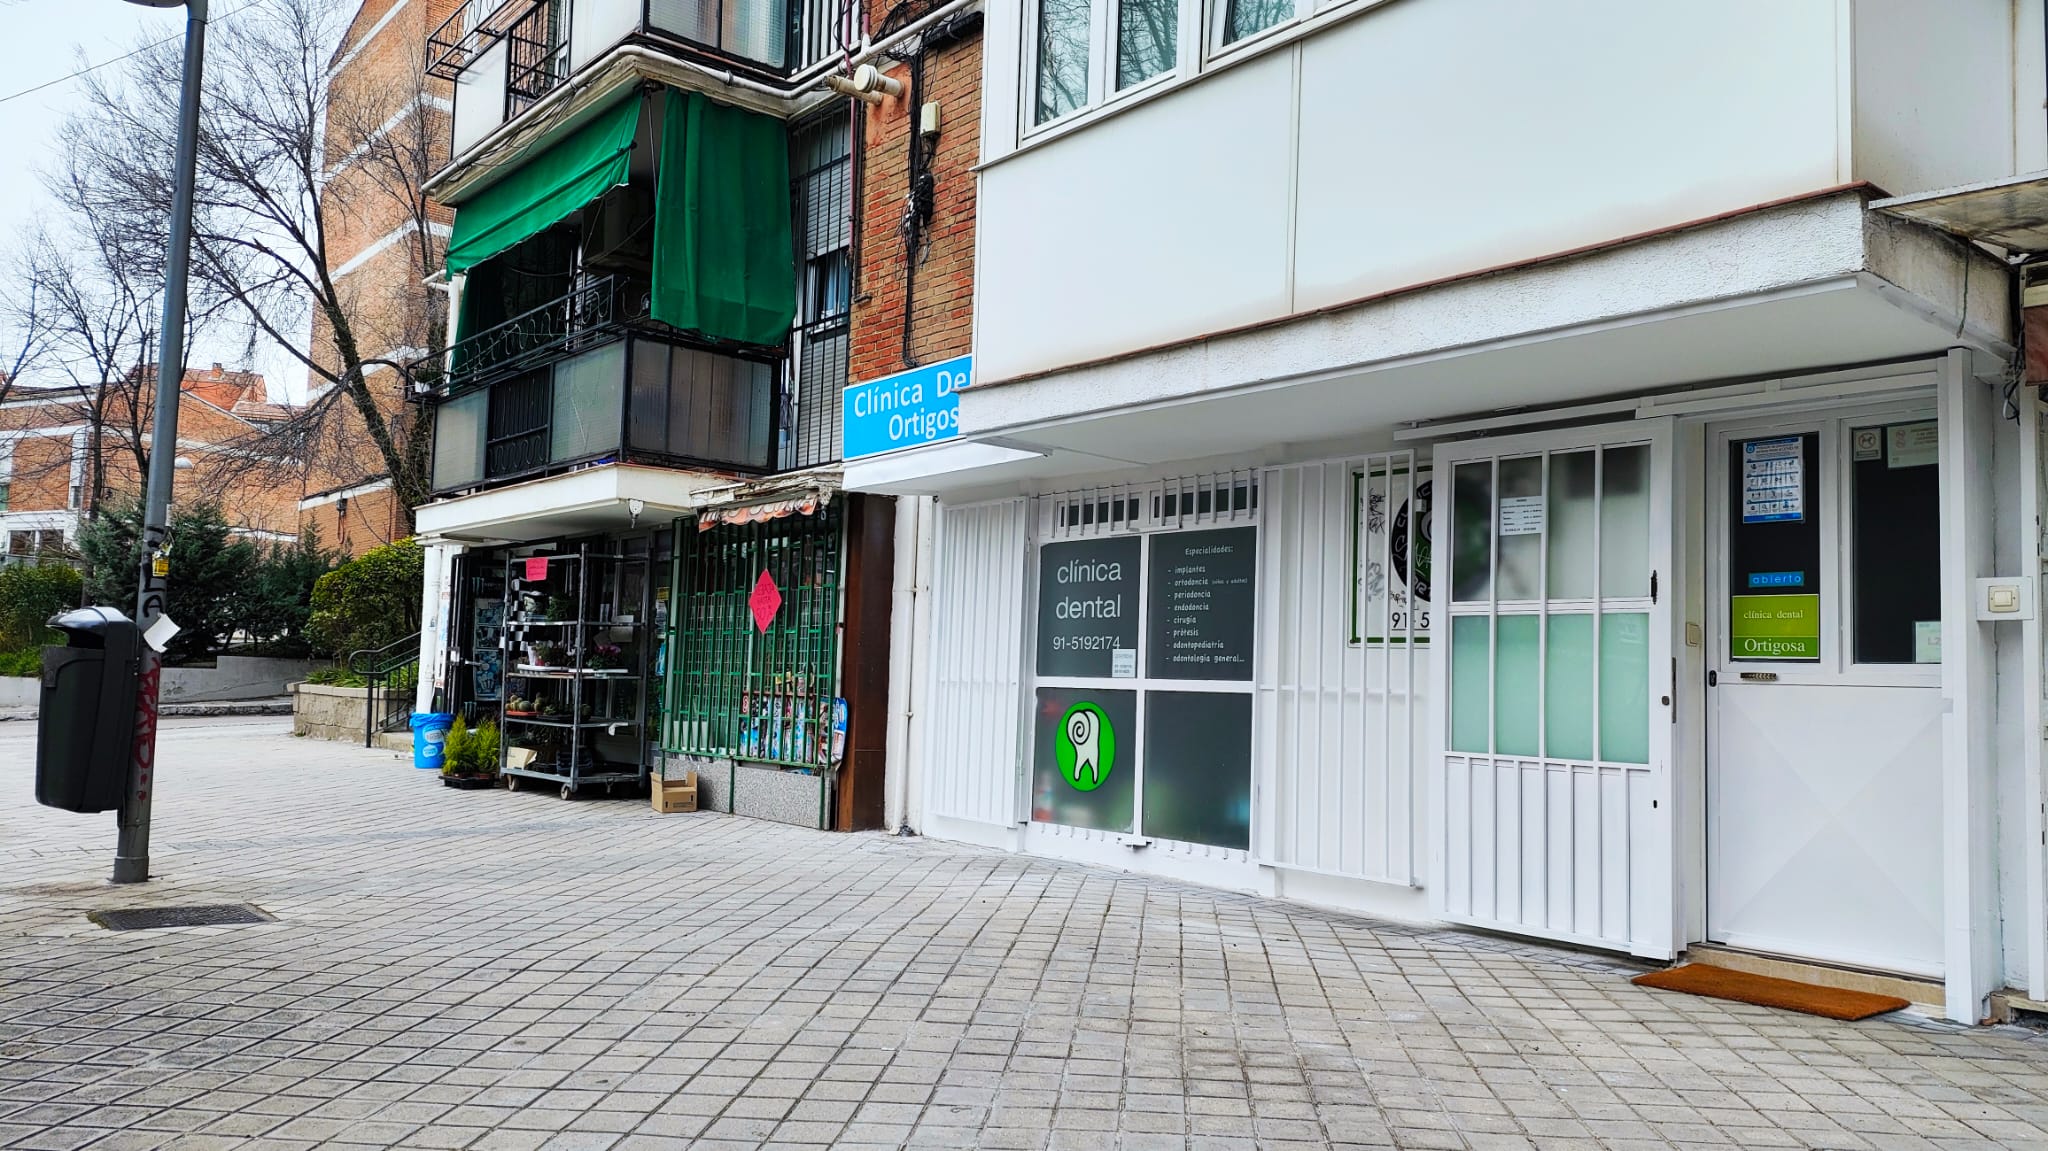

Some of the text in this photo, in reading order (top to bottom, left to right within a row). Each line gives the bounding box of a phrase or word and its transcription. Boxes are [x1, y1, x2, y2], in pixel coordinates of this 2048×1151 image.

[854, 383, 923, 418] Clínica
[1185, 545, 1234, 557] Especialidades:
[1057, 559, 1122, 584] clínica
[1174, 565, 1206, 575] implantes
[1174, 577, 1208, 587] ortodoncia
[1752, 574, 1802, 584] abierto
[1174, 589, 1211, 600] periodoncia
[1055, 594, 1121, 619] dental
[1174, 602, 1209, 611] endodoncia
[1743, 609, 1804, 619] clínica dental
[1173, 615, 1197, 625] cirugía
[1053, 636, 1120, 650] 91-5192174
[1173, 640, 1224, 650] odontopediatría
[1744, 638, 1806, 655] Ortigosa
